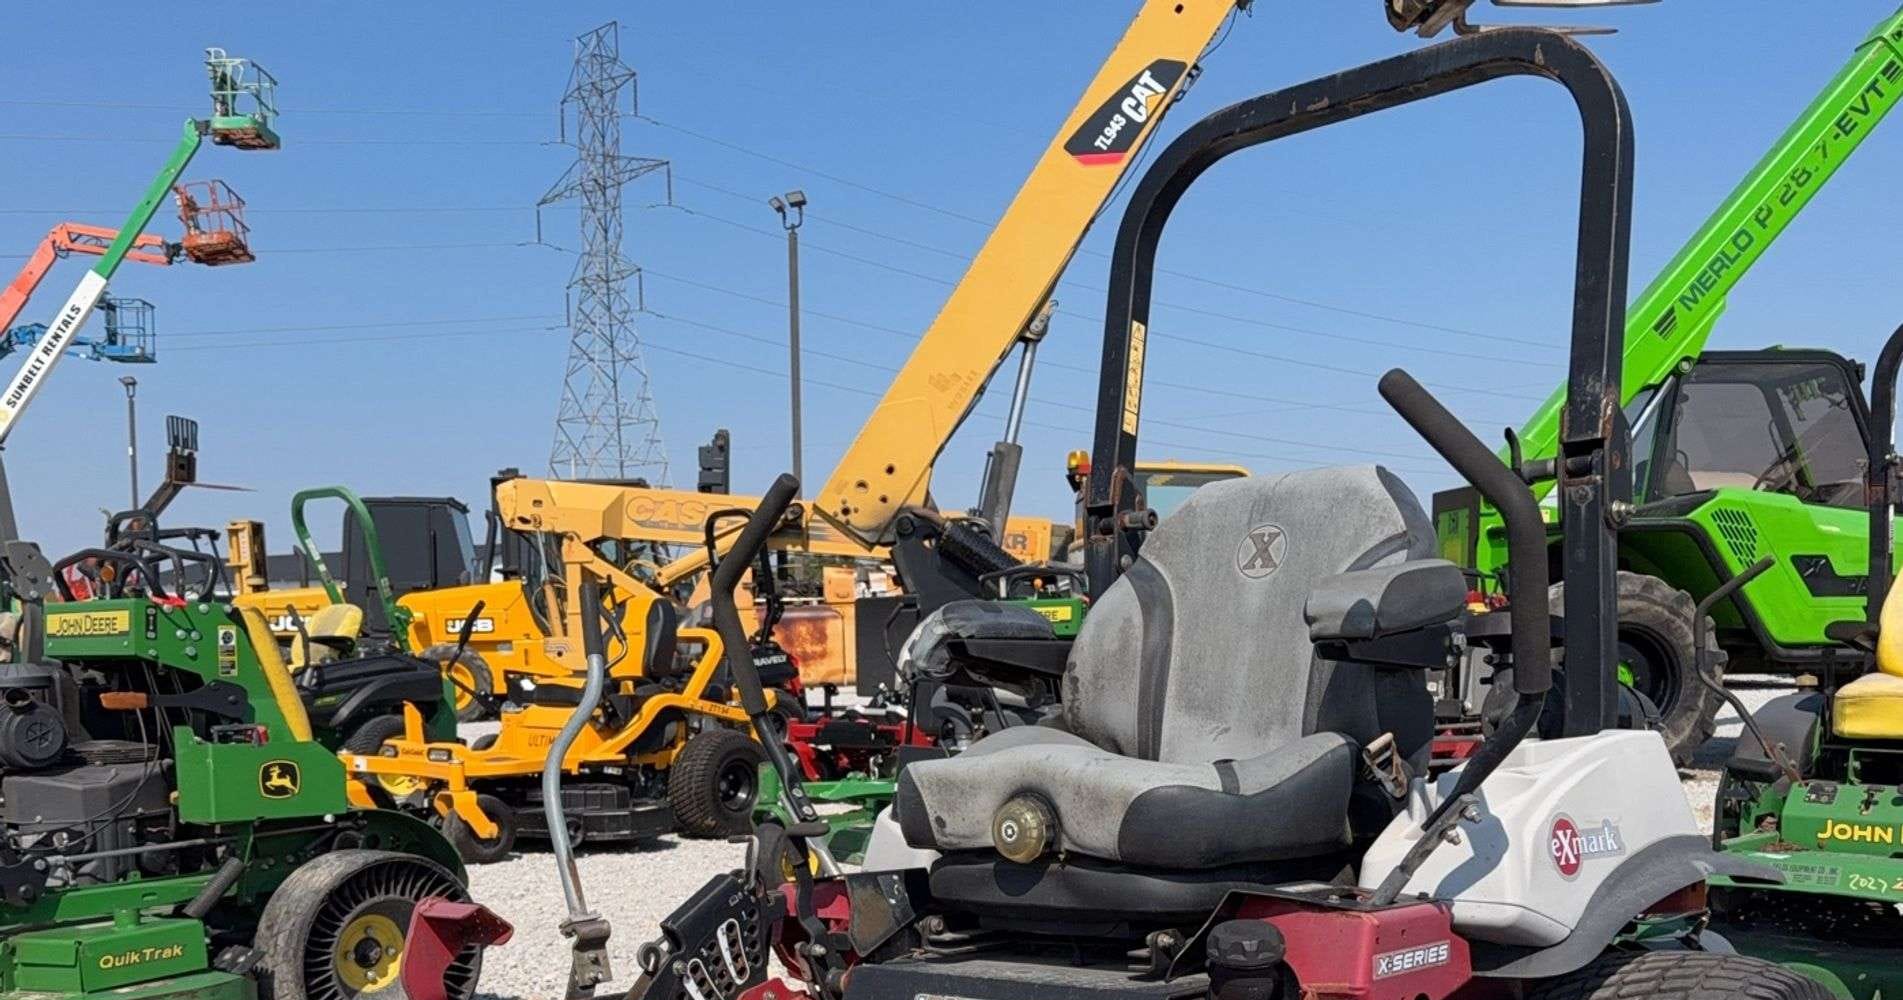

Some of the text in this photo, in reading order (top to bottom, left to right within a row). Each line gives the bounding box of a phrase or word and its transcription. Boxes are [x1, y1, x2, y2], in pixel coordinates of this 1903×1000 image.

[1094, 69, 1167, 151] TL943 CAT
[1678, 229, 1754, 312] MERLO
[6, 303, 82, 409] SUNBELT RENTALS
[1242, 531, 1281, 570] X
[56, 614, 118, 633] JOHN DEERE
[528, 734, 556, 748] ULTIM
[1817, 819, 1894, 844] JOHN
[1377, 943, 1449, 975] X-SERIES
